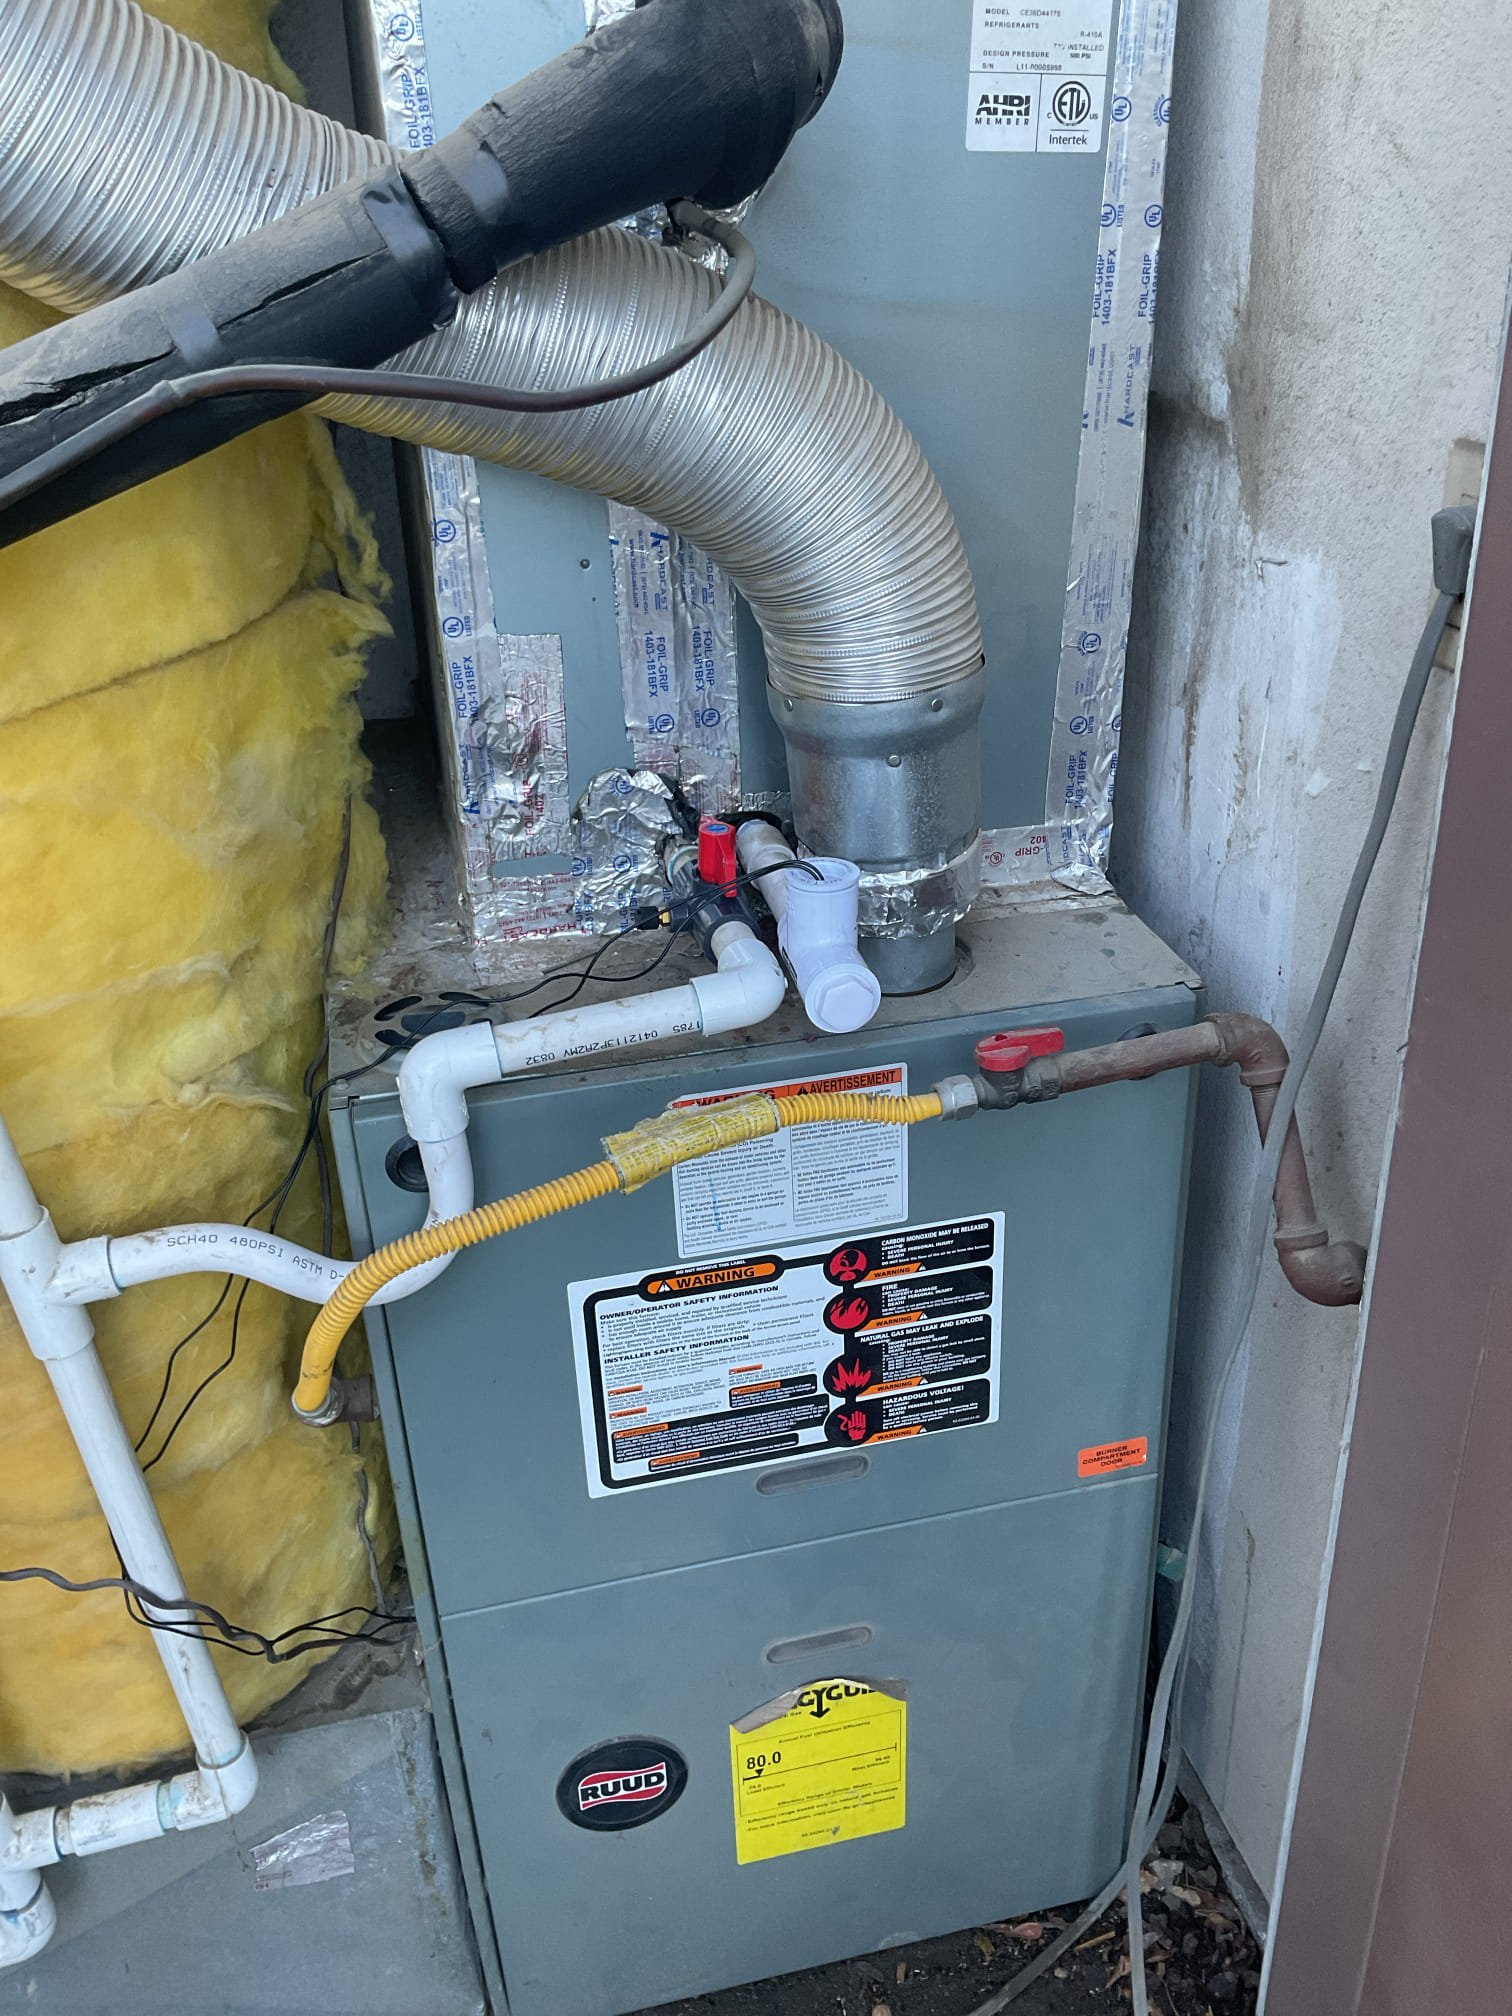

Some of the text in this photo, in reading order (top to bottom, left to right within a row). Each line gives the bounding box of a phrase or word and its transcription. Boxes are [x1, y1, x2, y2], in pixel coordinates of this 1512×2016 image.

[984, 21, 1040, 29] REFRIGERANTS
[975, 94, 1031, 116] AHRI
[975, 118, 1030, 126] MEMBER
[1049, 134, 1088, 145] Intertek
[1101, 248, 1117, 326] 1403-181BFX
[1138, 254, 1152, 318] FOIL-GRIP
[1124, 344, 1137, 414] HARDCAST
[656, 545, 669, 611] HARDCAST
[463, 615, 473, 637] LISTED
[644, 630, 659, 698] 1403-181BFX
[656, 637, 669, 692] FOIL-GRIP
[692, 624, 705, 692] 1403-181BFX
[703, 630, 715, 687] FOIL-GRIP
[452, 662, 468, 719] FOIL-GRIP
[1065, 754, 1078, 804] FOIL-GRIP
[525, 1053, 556, 1066] 0832
[809, 1070, 896, 1094] AVERTISSEMENT
[881, 1237, 905, 1246] CARBON
[906, 1232, 937, 1242] MONOXIDE
[961, 1223, 989, 1232] RELEASED
[167, 1234, 218, 1248] SCH40
[229, 1236, 284, 1259] 480PSI
[292, 1255, 323, 1276] ASTM
[676, 1267, 755, 1289] WARNING
[874, 1266, 910, 1278] WARNING
[882, 1283, 898, 1291] FIRE
[599, 1285, 778, 1320] OWNER/OPERATOR SAFETY INFORMATION
[860, 1333, 890, 1343] NATURAL
[906, 1327, 921, 1335] MAY
[940, 1321, 954, 1329] AND
[955, 1316, 984, 1325] EXPLODE
[875, 1314, 911, 1326] WARNING
[603, 1334, 749, 1363] INSTALLER SAFETY INFORMATION
[877, 1380, 912, 1391] WARNING
[883, 1385, 964, 1404] HAZARDOUS VOLTAGE!
[877, 1428, 911, 1440] WARNING
[1082, 1448, 1141, 1465] COMPARTMENT
[1096, 1445, 1128, 1457] BURNER
[1101, 1458, 1123, 1467] DOOR
[746, 1751, 781, 1769] 80.0
[580, 1771, 665, 1802] RUUD
